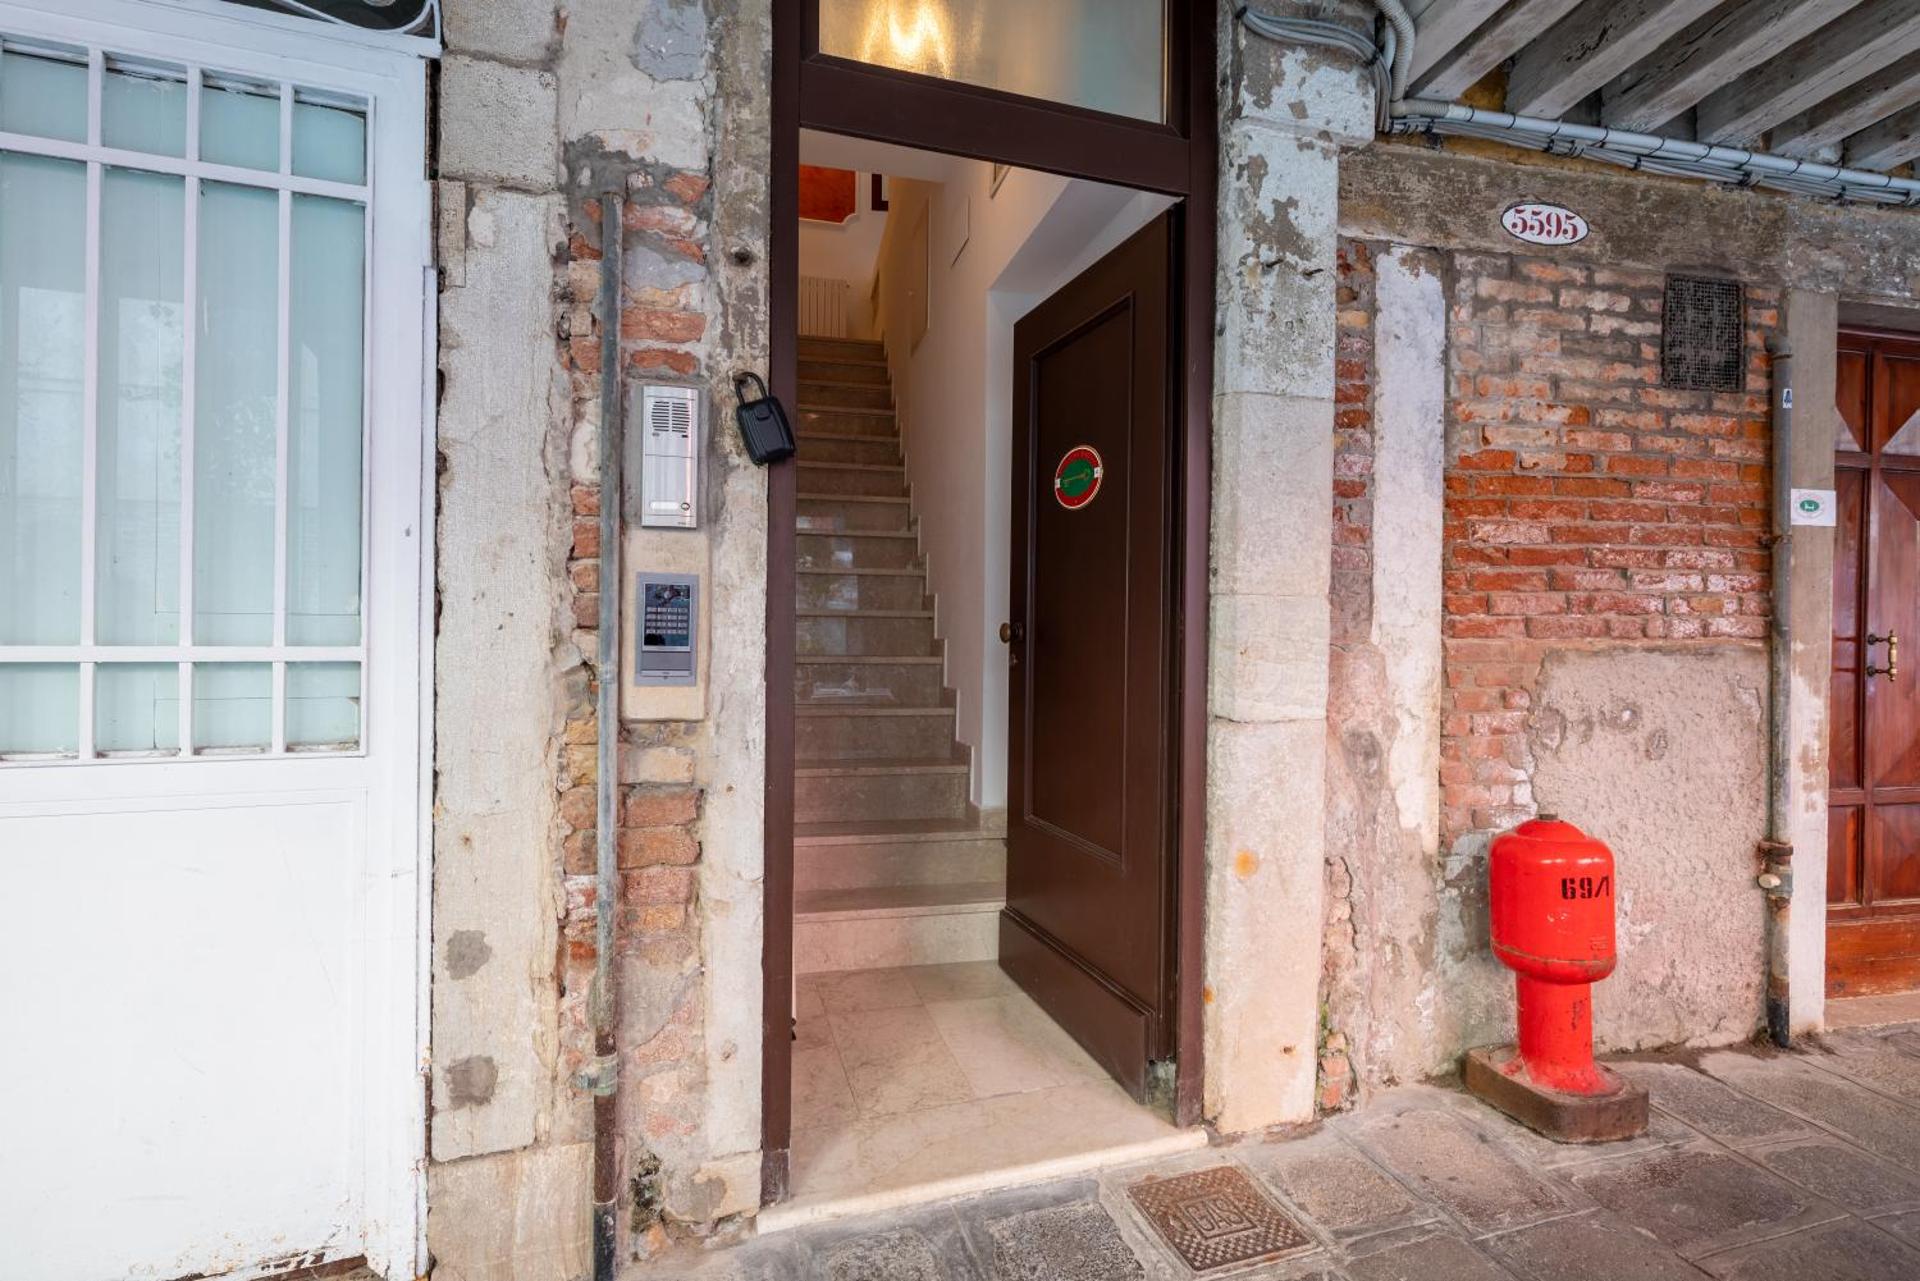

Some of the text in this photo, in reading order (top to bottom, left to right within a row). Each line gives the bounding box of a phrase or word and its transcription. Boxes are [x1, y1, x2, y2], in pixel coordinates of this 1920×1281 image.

[1511, 208, 1578, 240] 5595
[1561, 875, 1610, 900] 69/1
[1184, 1196, 1245, 1232] GAS
